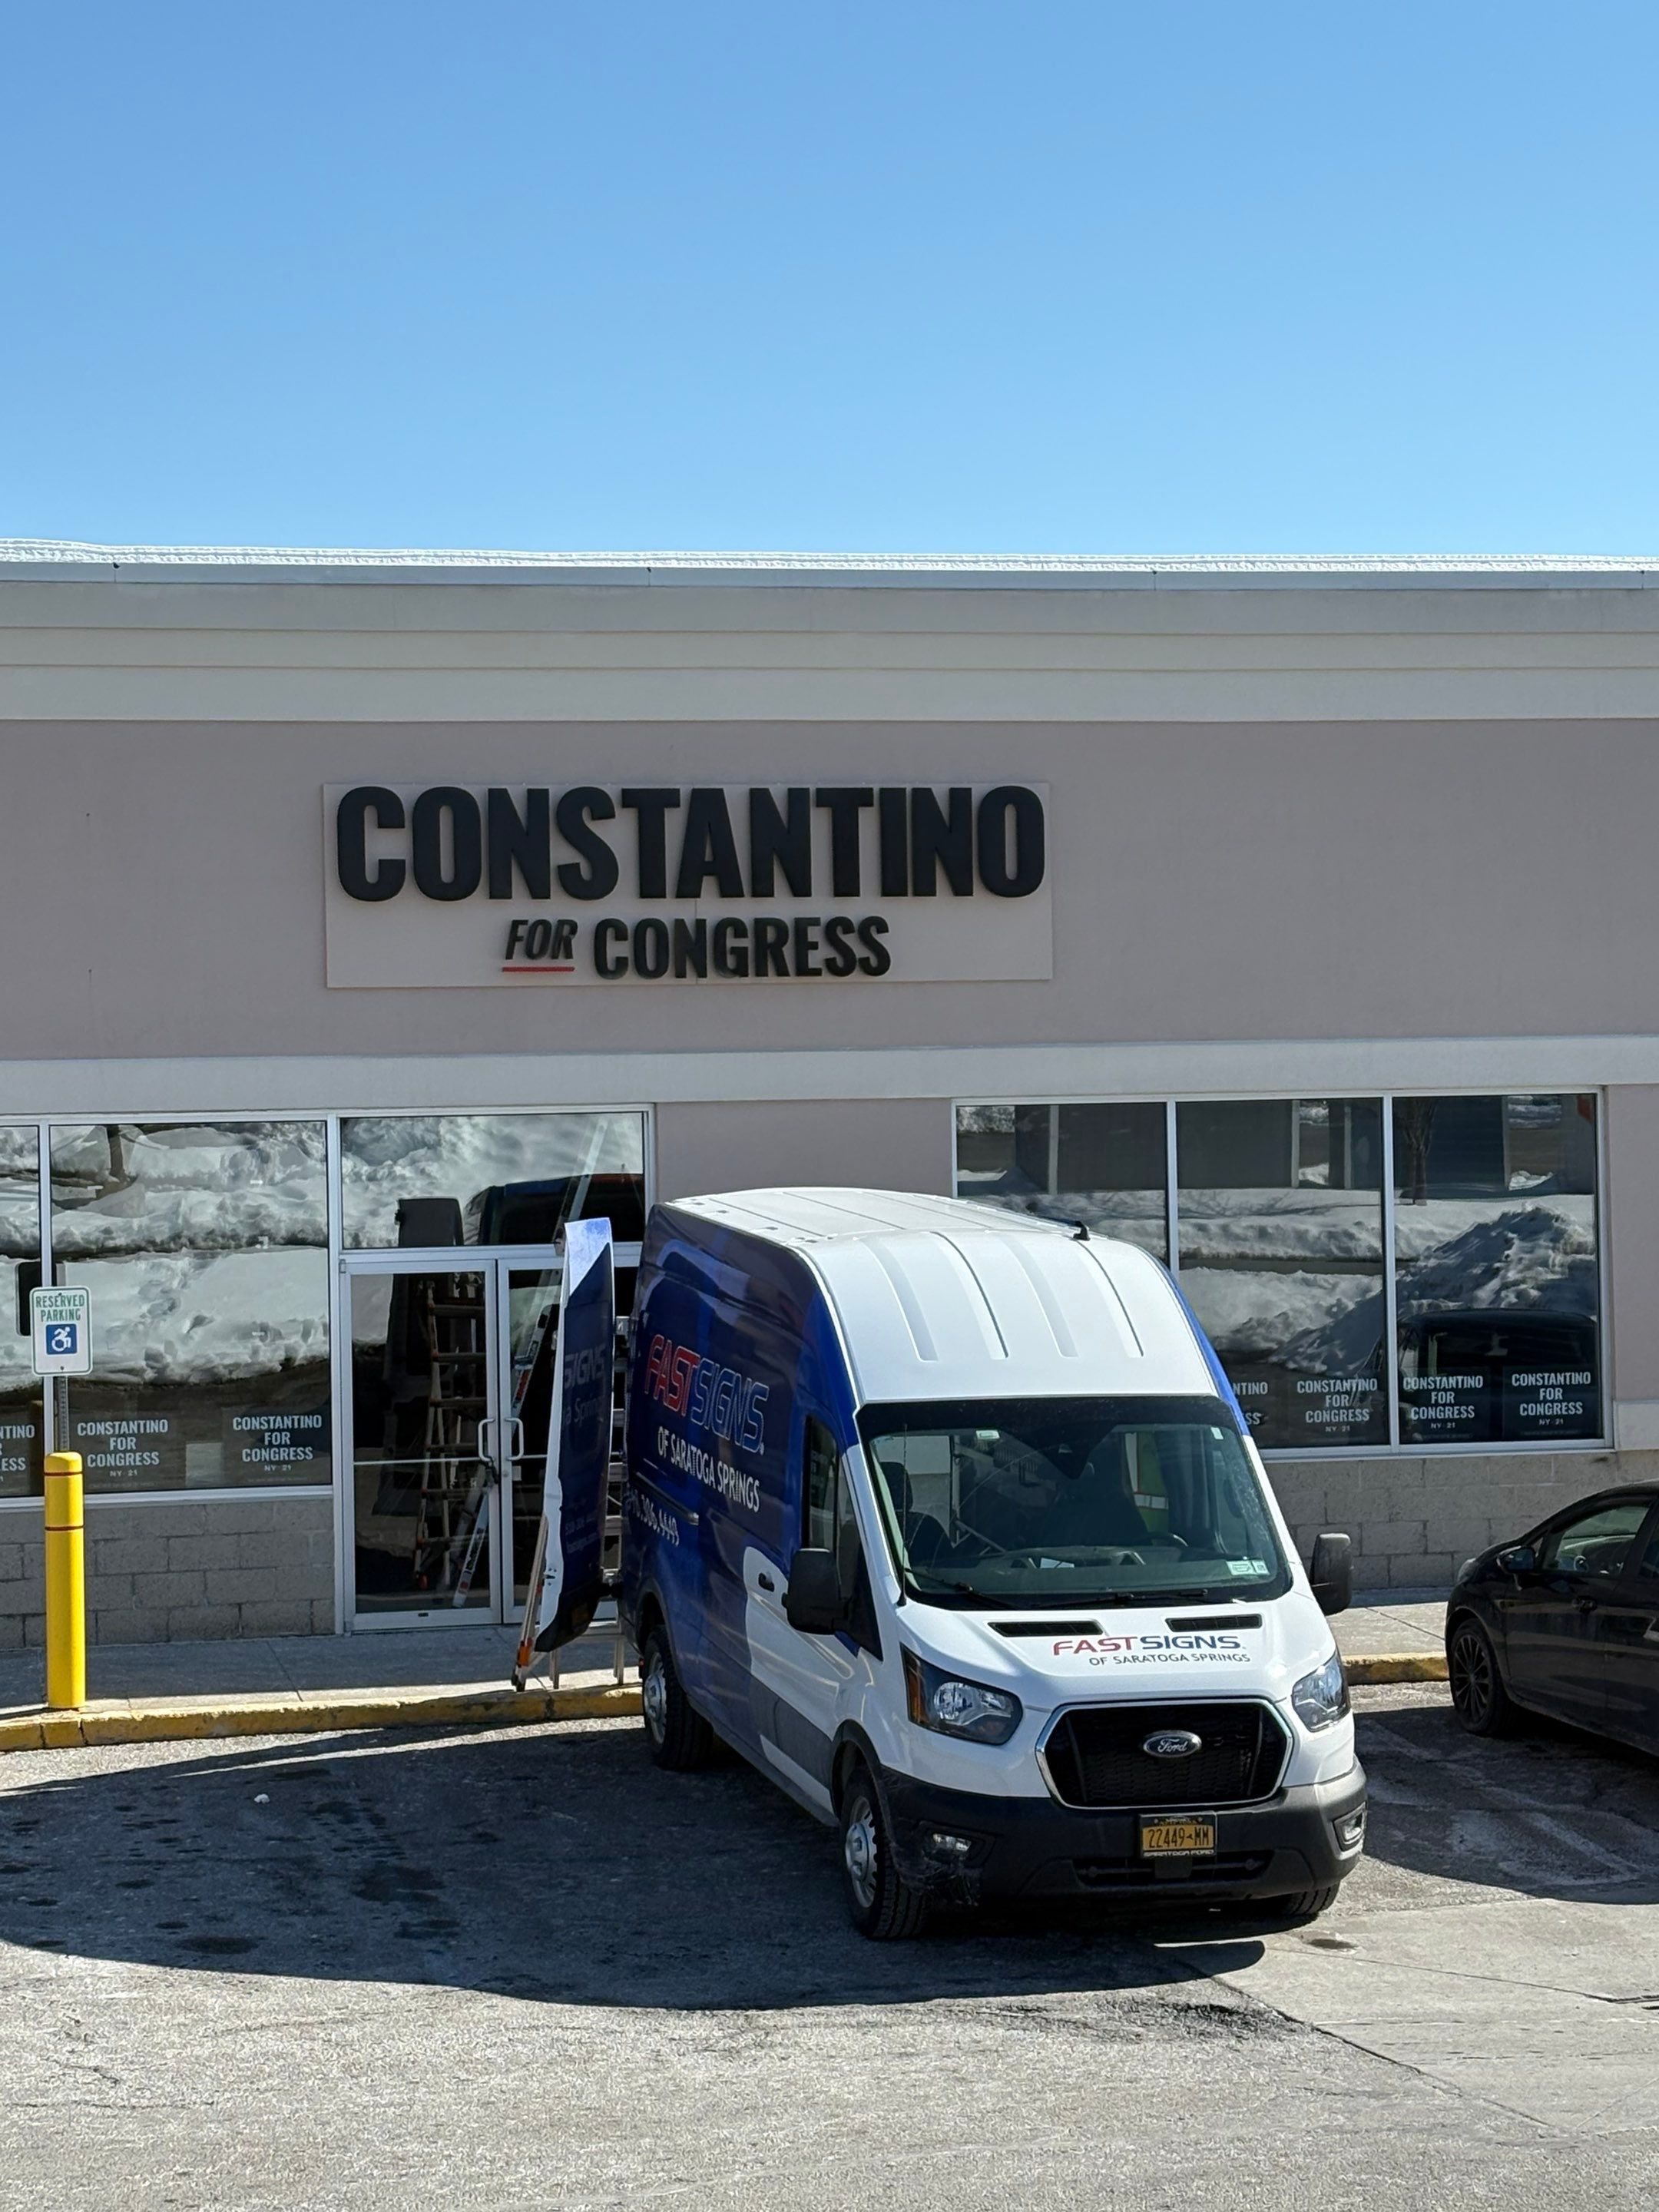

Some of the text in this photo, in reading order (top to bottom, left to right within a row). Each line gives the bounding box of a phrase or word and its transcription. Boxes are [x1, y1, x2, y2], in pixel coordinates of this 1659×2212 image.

[336, 786, 1045, 902] CONSTANTINO
[505, 916, 891, 979] FOR CONGRESS
[35, 1294, 85, 1308] RESERVED
[41, 1308, 81, 1322] PARKING
[1296, 1378, 1378, 1394] CONSTANTINO
[1403, 1375, 1483, 1390] CONSTANTINO
[1512, 1372, 1591, 1386] CONSTANTINO
[1326, 1394, 1349, 1407] FOR
[1431, 1392, 1455, 1404] FOR
[1539, 1388, 1563, 1400] FOR
[1306, 1409, 1369, 1423] CONGRESS
[1411, 1406, 1475, 1420] CONGRESS
[1519, 1402, 1583, 1416] CONGRESS
[77, 1419, 168, 1436] CONSTANTINO
[233, 1415, 322, 1430] CONSTANTINO
[110, 1437, 136, 1451] FOR
[264, 1432, 290, 1445] FOR
[87, 1452, 160, 1467] CONGRESS
[242, 1447, 313, 1462] CONGRESS
[657, 1426, 760, 1512] OF SARATOGA SPRINGS
[1089, 1653, 1250, 1666] OF SARATOGA SPRINGS
[1157, 1738, 1188, 1753] Ford
